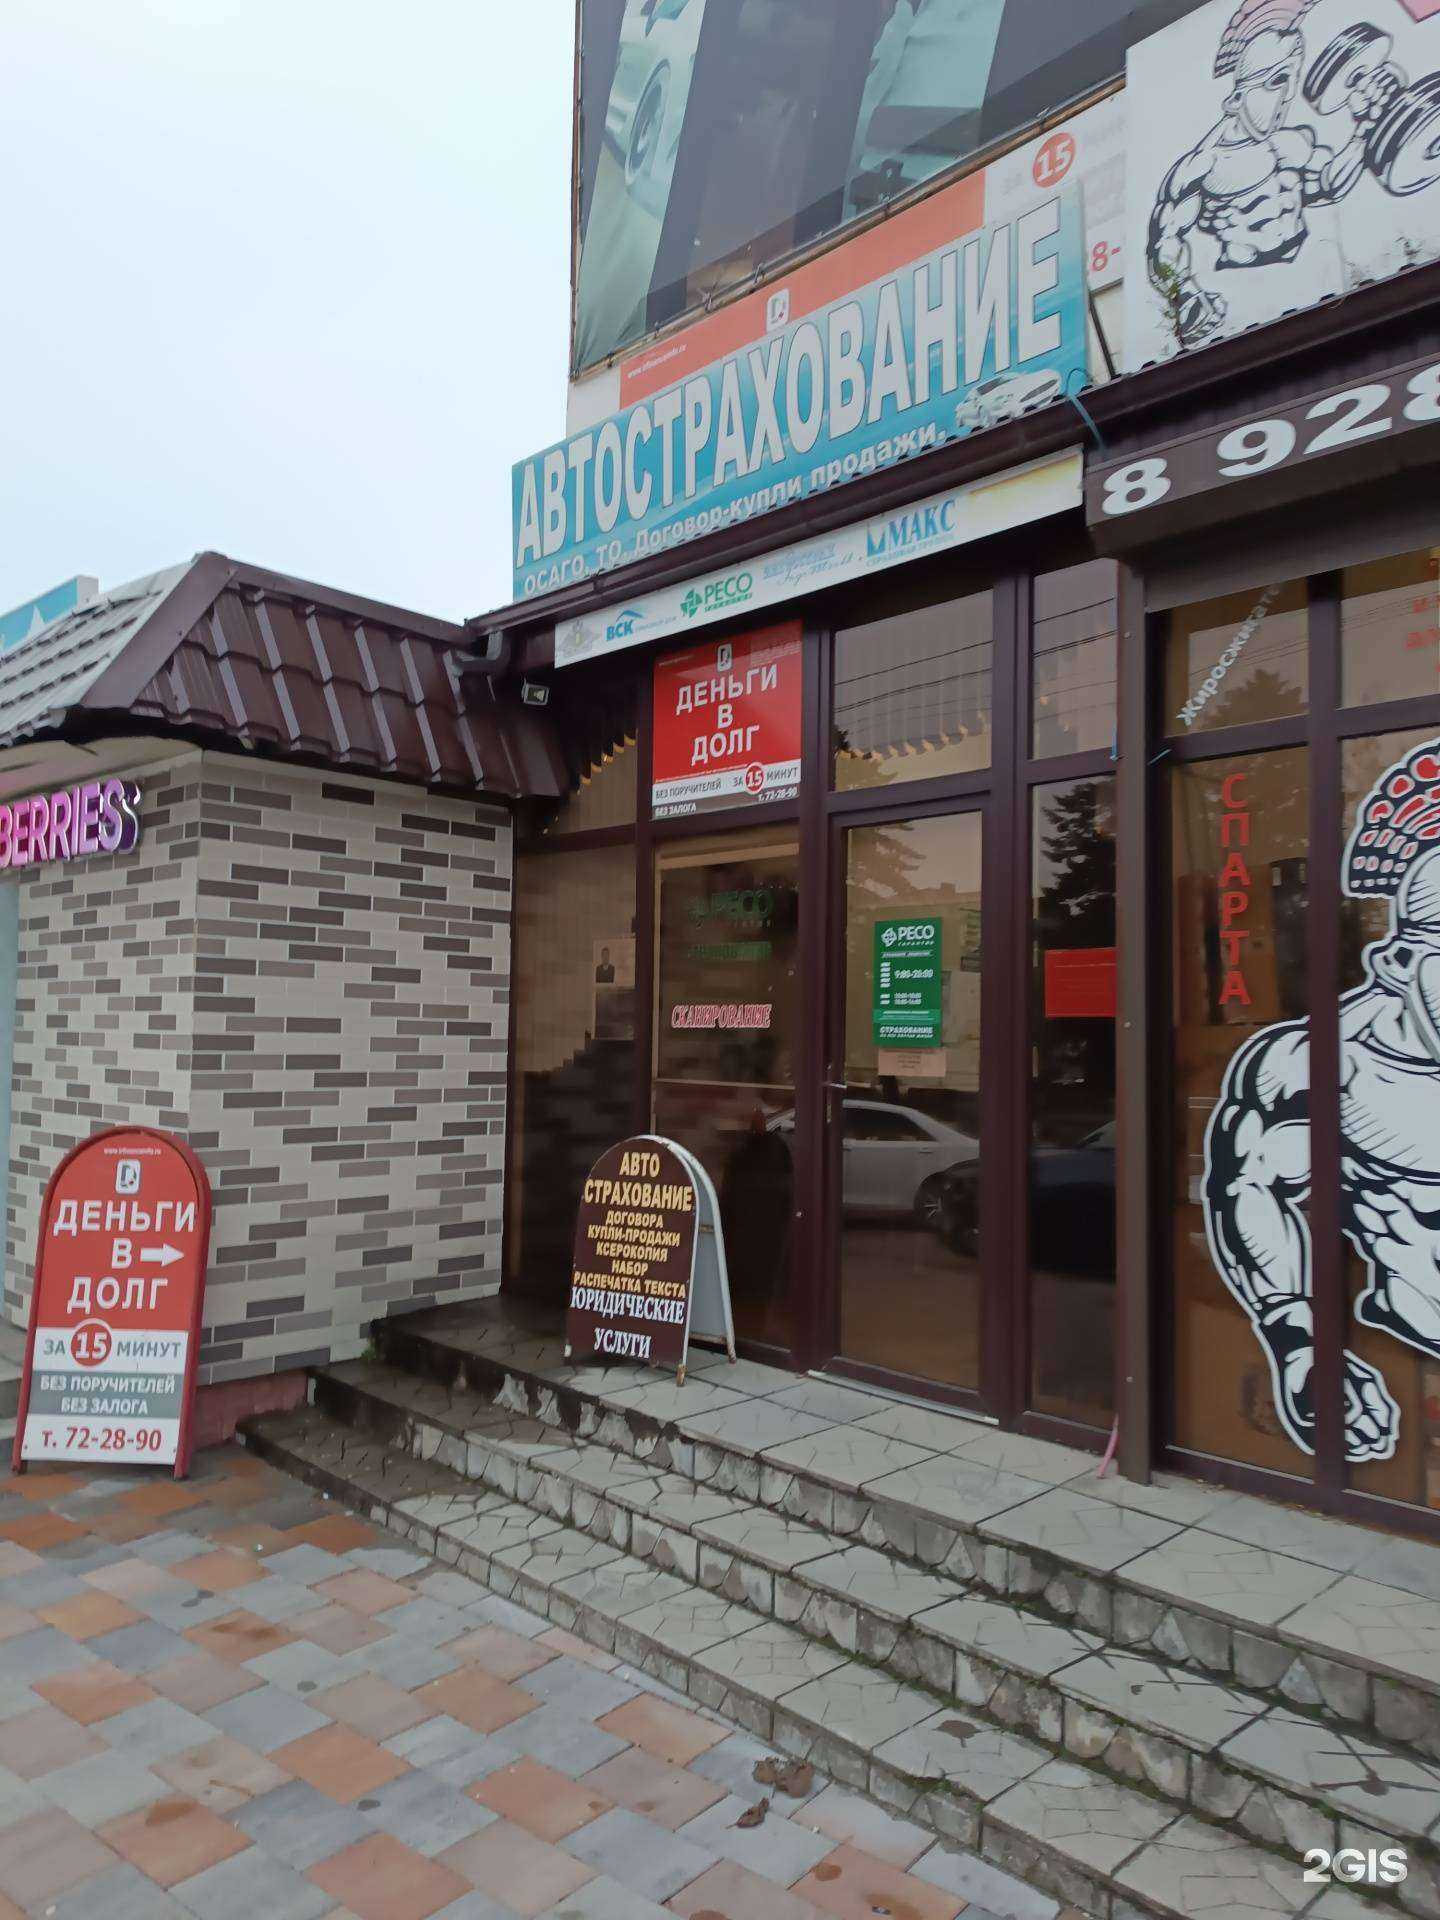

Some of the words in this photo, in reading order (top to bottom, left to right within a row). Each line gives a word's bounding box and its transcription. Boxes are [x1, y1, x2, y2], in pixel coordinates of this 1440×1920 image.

[1036, 138, 1073, 183] 15
[515, 195, 1063, 569] АВТОСТРАХОВАНИЕ
[1102, 458, 1171, 515] 8
[633, 475, 802, 552] Договор-купли
[889, 500, 958, 547] МАКС
[704, 572, 753, 604] РЕСО
[606, 619, 635, 642] ВСК
[675, 664, 778, 716] ДЕНЬГИ
[717, 703, 734, 729] В
[691, 724, 760, 766] ДОЛГ
[655, 786, 669, 800] БЕЗ
[669, 778, 722, 798] ПОРУЧИТЕЛЕЙ
[733, 776, 744, 787] ЗА
[746, 770, 763, 788] 15
[766, 767, 798, 781] МИНУТ
[0, 777, 140, 868] BERRIES
[669, 802, 697, 815] ЗАЛОГА
[1218, 773, 1252, 1005] СПАРТА
[897, 925, 935, 941] РЕСО
[671, 1004, 773, 1029] СКАНИРОВАНИЕ
[619, 1151, 661, 1178] АВТО
[584, 1178, 693, 1213] СТРАХОВАНИЕ
[53, 1199, 195, 1237] ДЕНЬГИ
[605, 1209, 664, 1229] ДОГОВОРА
[587, 1224, 681, 1248] КУПЛИ-ПРОДАЖИ
[111, 1237, 133, 1270] В
[596, 1242, 669, 1263] КСЕРОКОПИЯ
[611, 1259, 649, 1277] НАБОР
[66, 1276, 169, 1315] ДОЛГ
[573, 1270, 641, 1295] РАСПЕЧАТКА
[643, 1279, 687, 1299] ТЕКСТА
[569, 1285, 686, 1326] ЮРИДИЧЕСКИЕ
[43, 1339, 66, 1356] ЗА
[76, 1332, 108, 1360] 15
[116, 1341, 181, 1357] МИНУТ
[593, 1326, 652, 1360] УСЛУГИ
[40, 1374, 66, 1391] БЕЗ
[70, 1374, 176, 1394] ПОРУЧИТЕЛЕЙ
[61, 1397, 88, 1414] БЕЗ
[91, 1398, 148, 1414] ЗАЛОГА
[65, 1426, 162, 1451] 72-28-90
